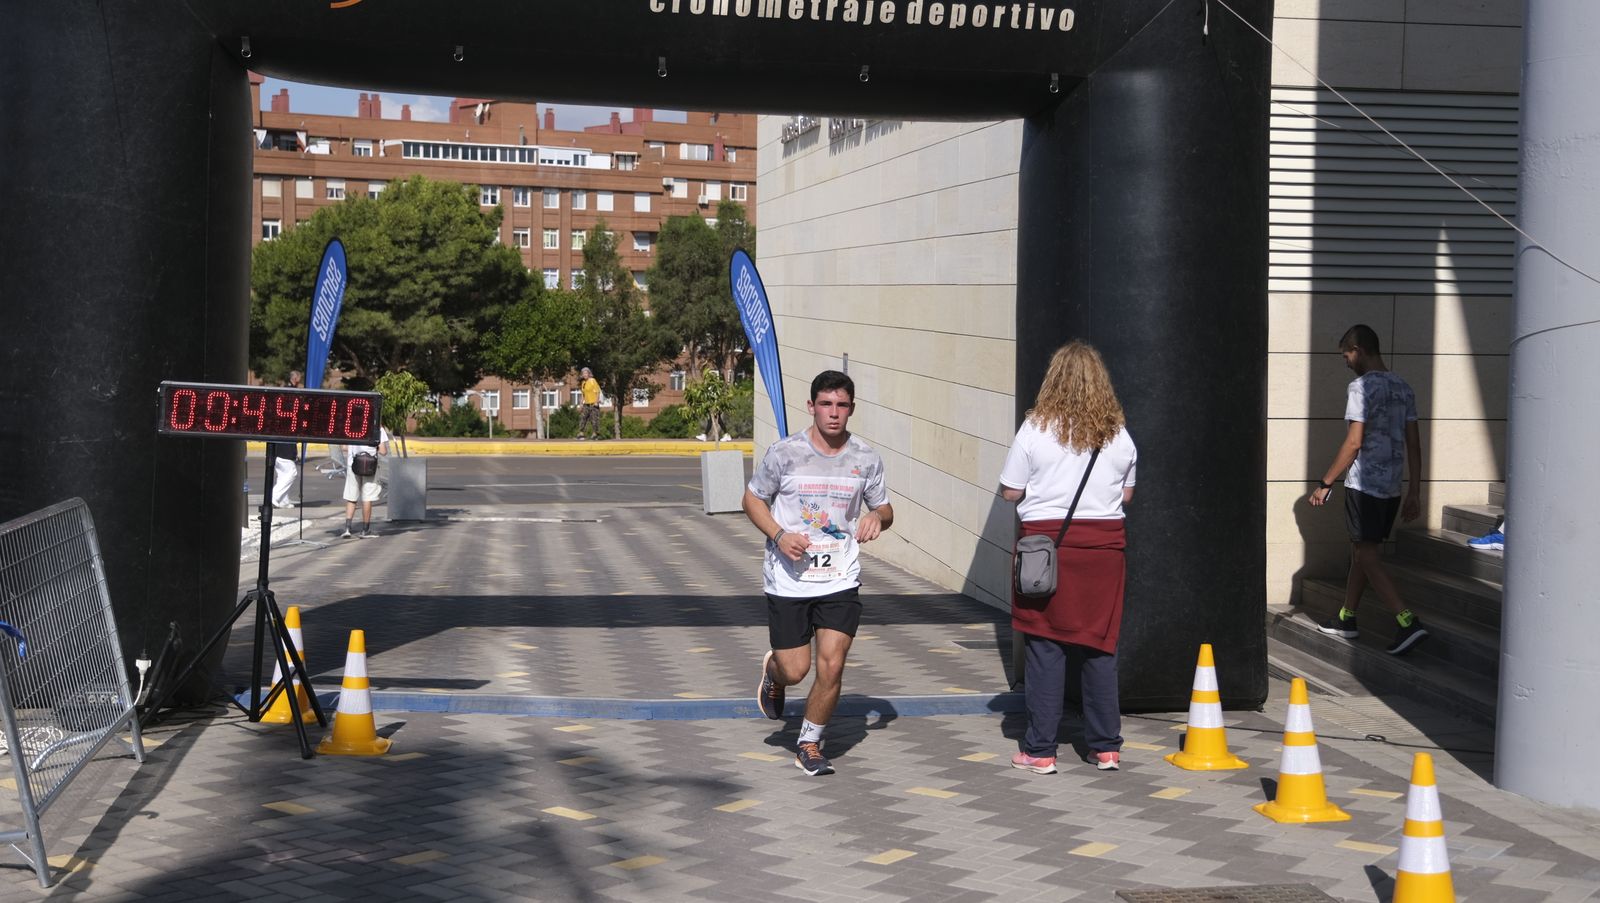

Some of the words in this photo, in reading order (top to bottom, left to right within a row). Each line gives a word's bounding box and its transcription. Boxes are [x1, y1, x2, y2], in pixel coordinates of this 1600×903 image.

[907, 0, 1074, 32] deportivo
[170, 389, 370, 438] 00:44:10
[811, 554, 832, 568] 12
